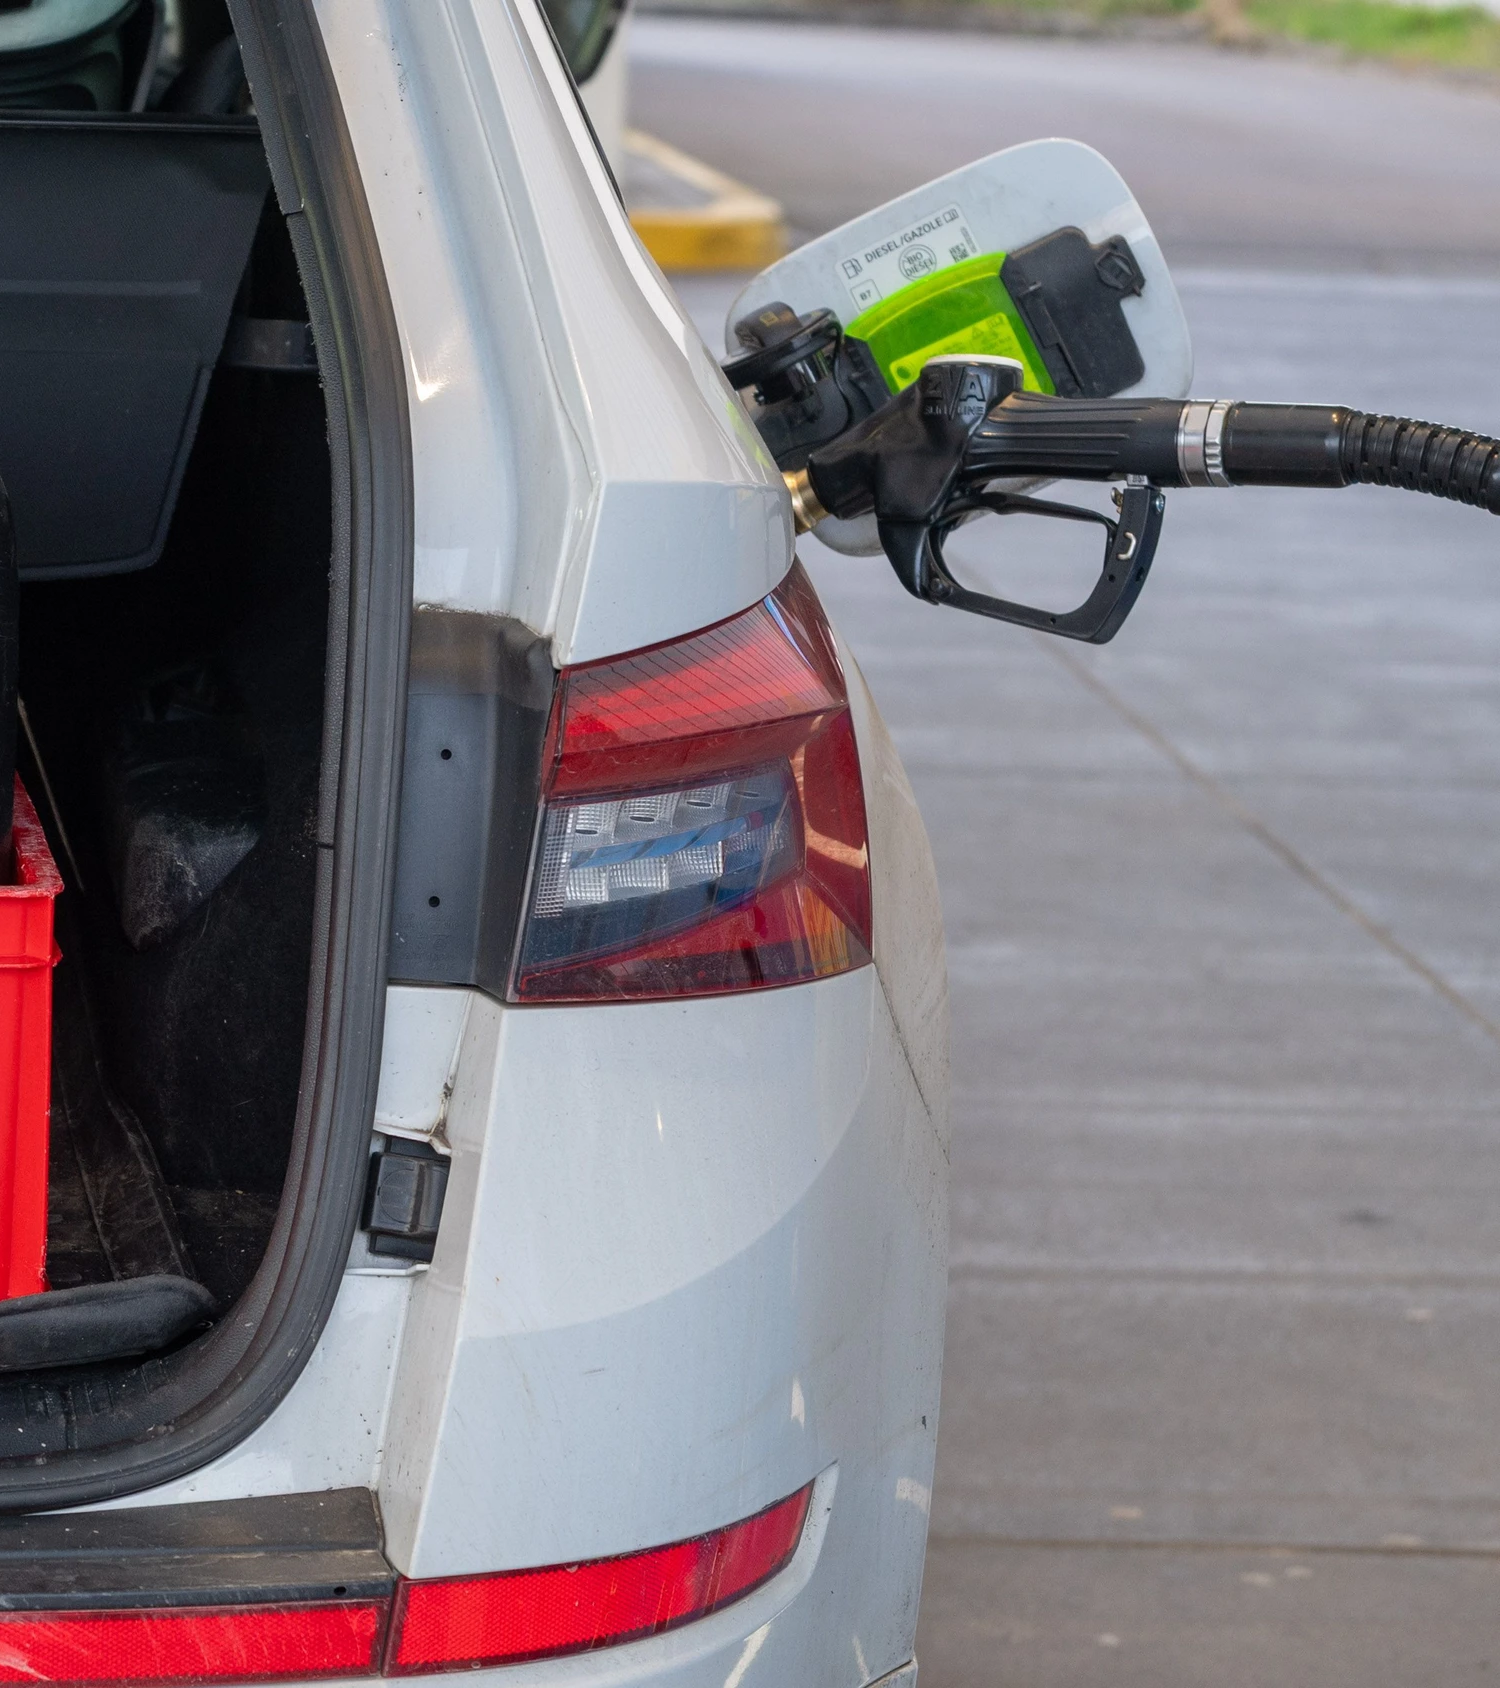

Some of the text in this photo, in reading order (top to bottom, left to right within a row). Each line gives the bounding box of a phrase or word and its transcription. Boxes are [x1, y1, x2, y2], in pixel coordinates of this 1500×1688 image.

[864, 217, 943, 263] DIESEL/GAZOLE
[905, 251, 924, 265] BIO
[905, 258, 935, 278] DIESEL
[859, 289, 873, 302] B7
